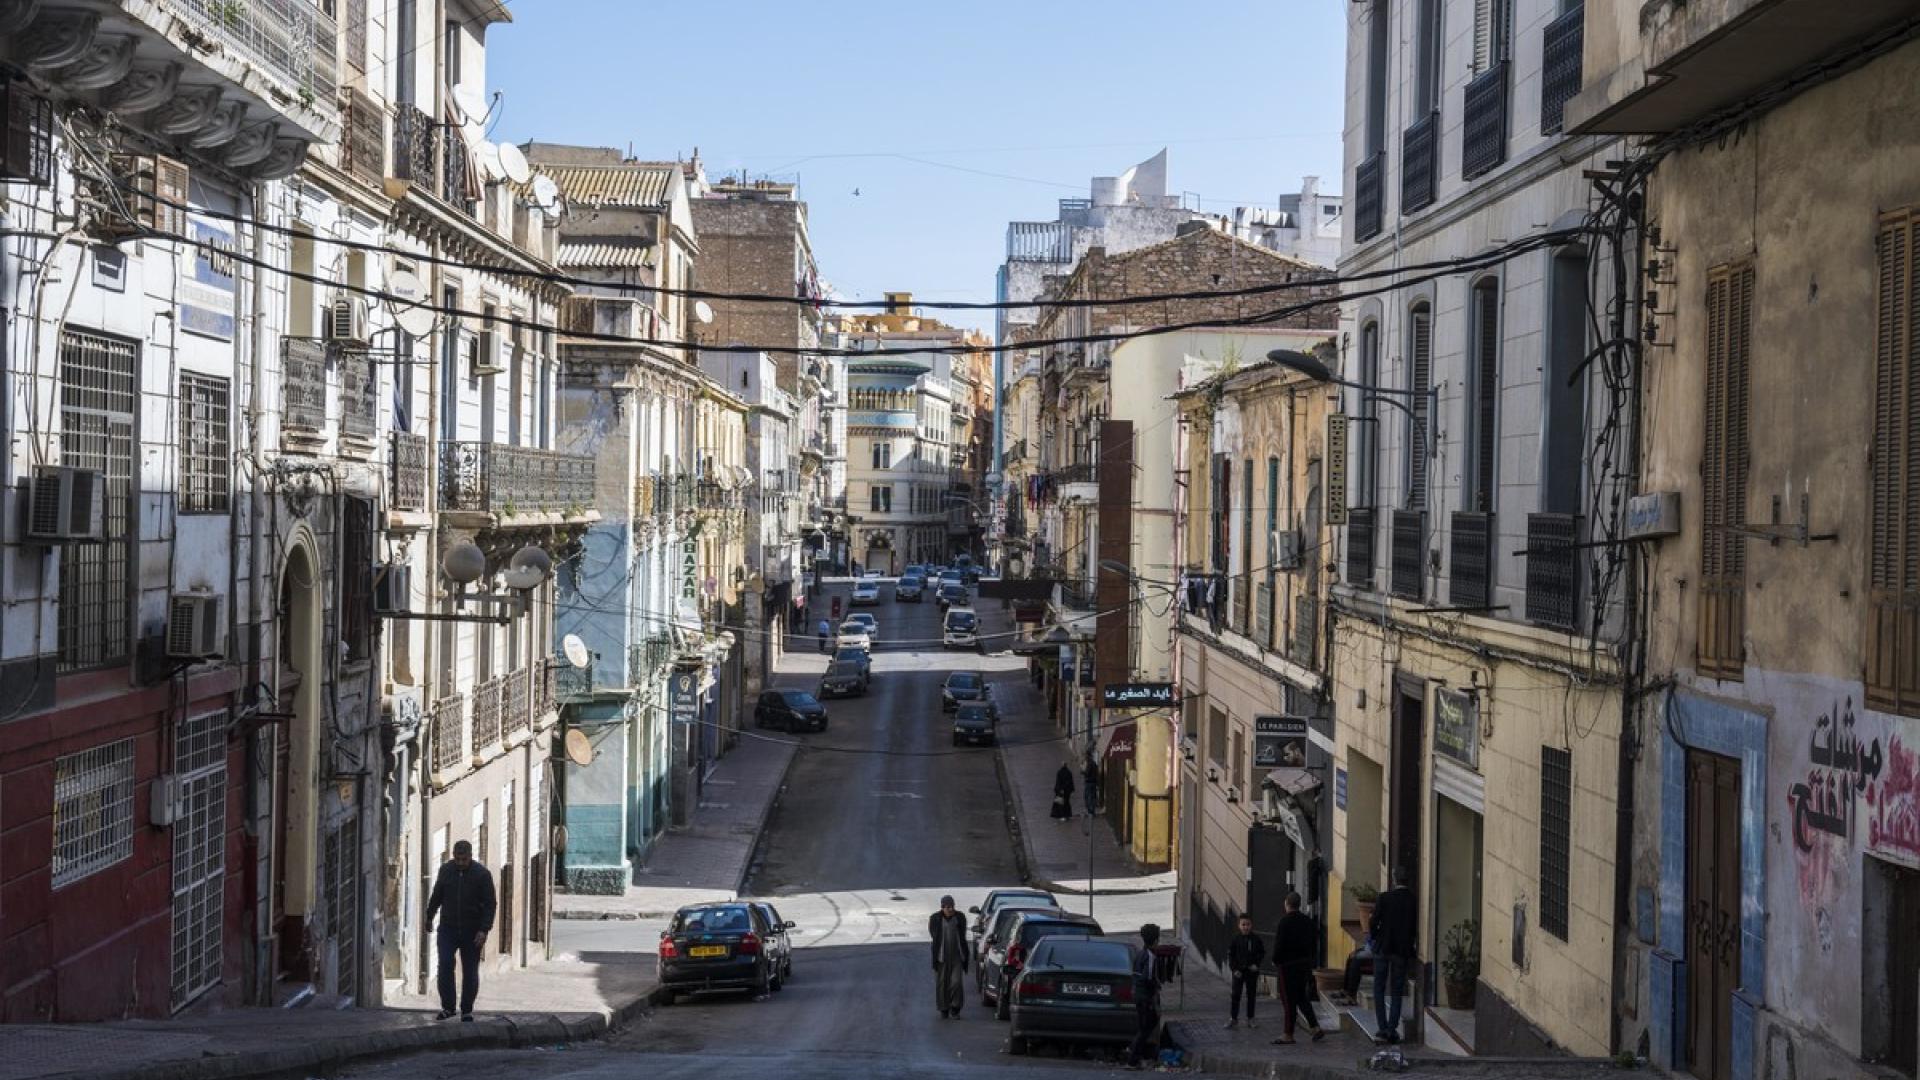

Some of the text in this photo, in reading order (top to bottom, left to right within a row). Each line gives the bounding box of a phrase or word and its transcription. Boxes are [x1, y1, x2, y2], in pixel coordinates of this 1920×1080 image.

[1331, 419, 1343, 446] HOTEL
[683, 542, 696, 598] BAZAR
[1257, 722, 1305, 731] LE PARISIEN
[1791, 768, 1855, 853] الفتح
